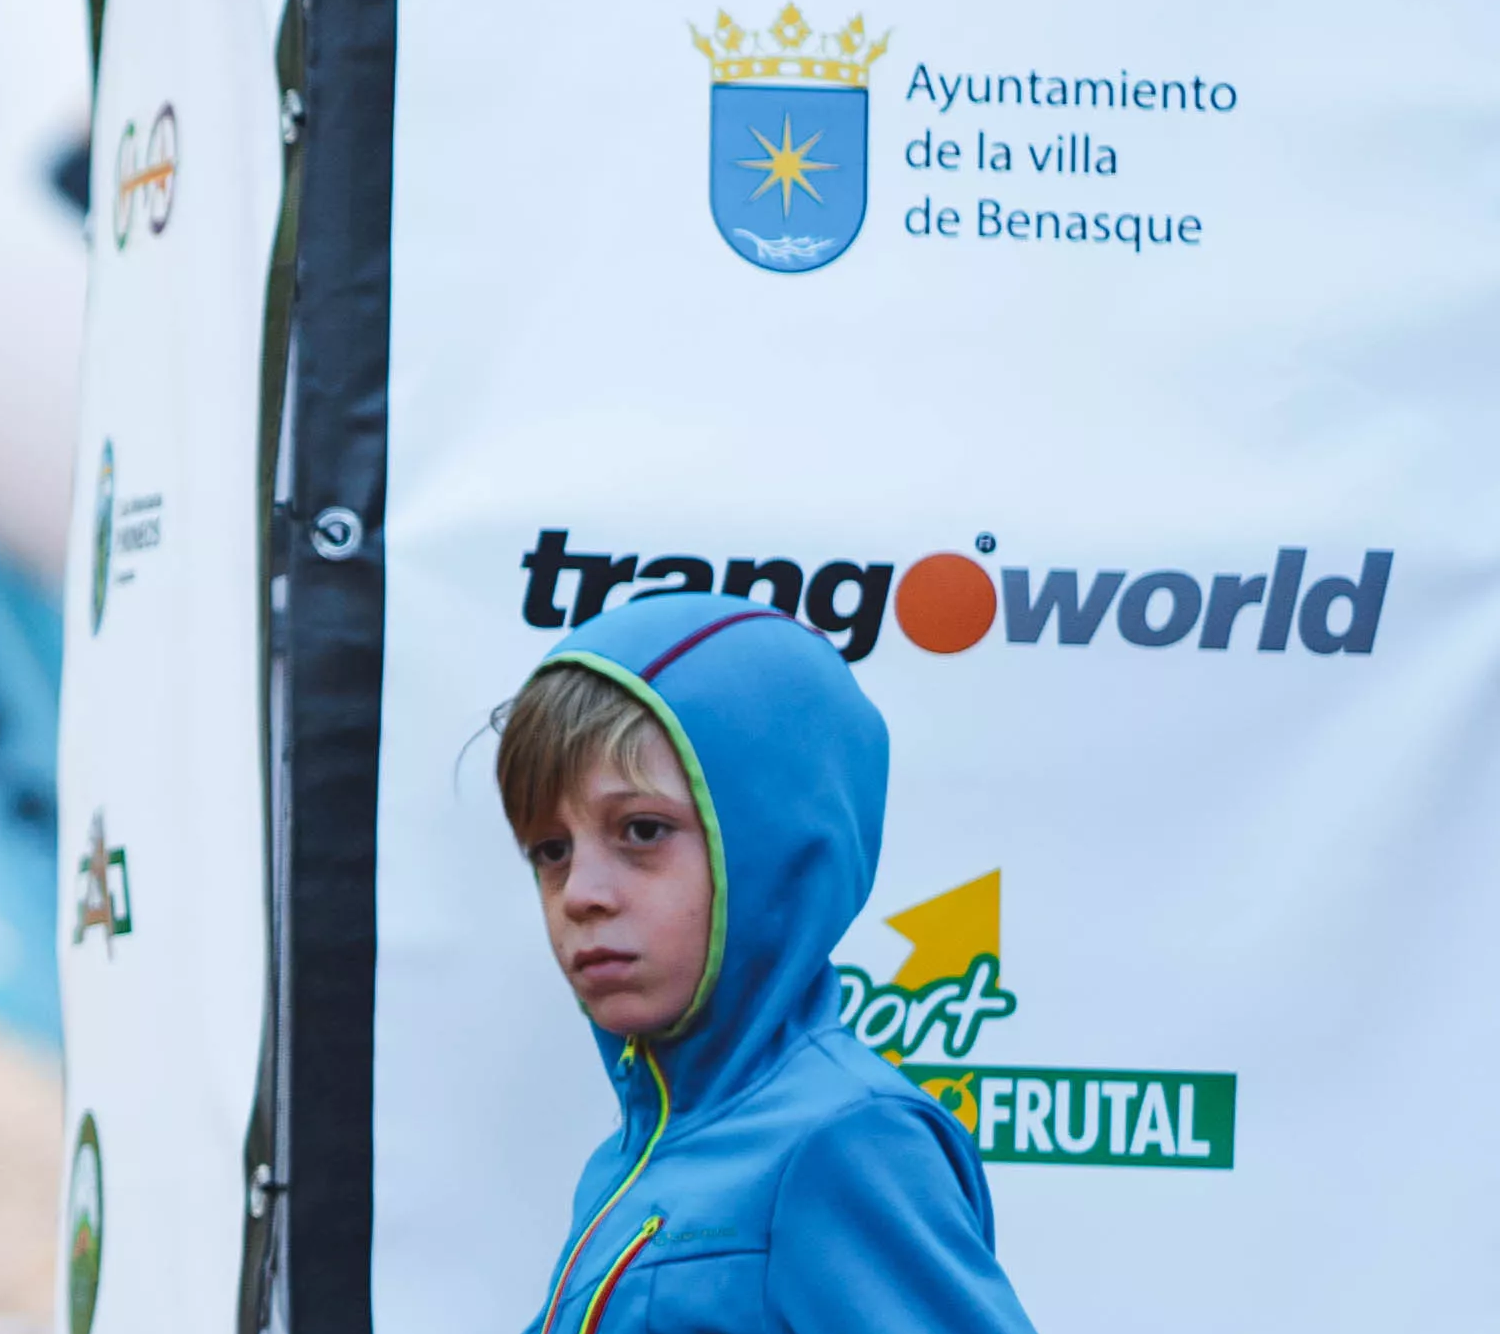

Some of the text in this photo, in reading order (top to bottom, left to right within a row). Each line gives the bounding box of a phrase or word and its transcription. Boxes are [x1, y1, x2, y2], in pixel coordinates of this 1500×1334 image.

[905, 62, 1238, 116] Ayuntamiento
[905, 130, 1119, 178] de la villa
[903, 198, 1203, 253] de Benasque
[979, 1076, 1211, 1158] FRUTAL
